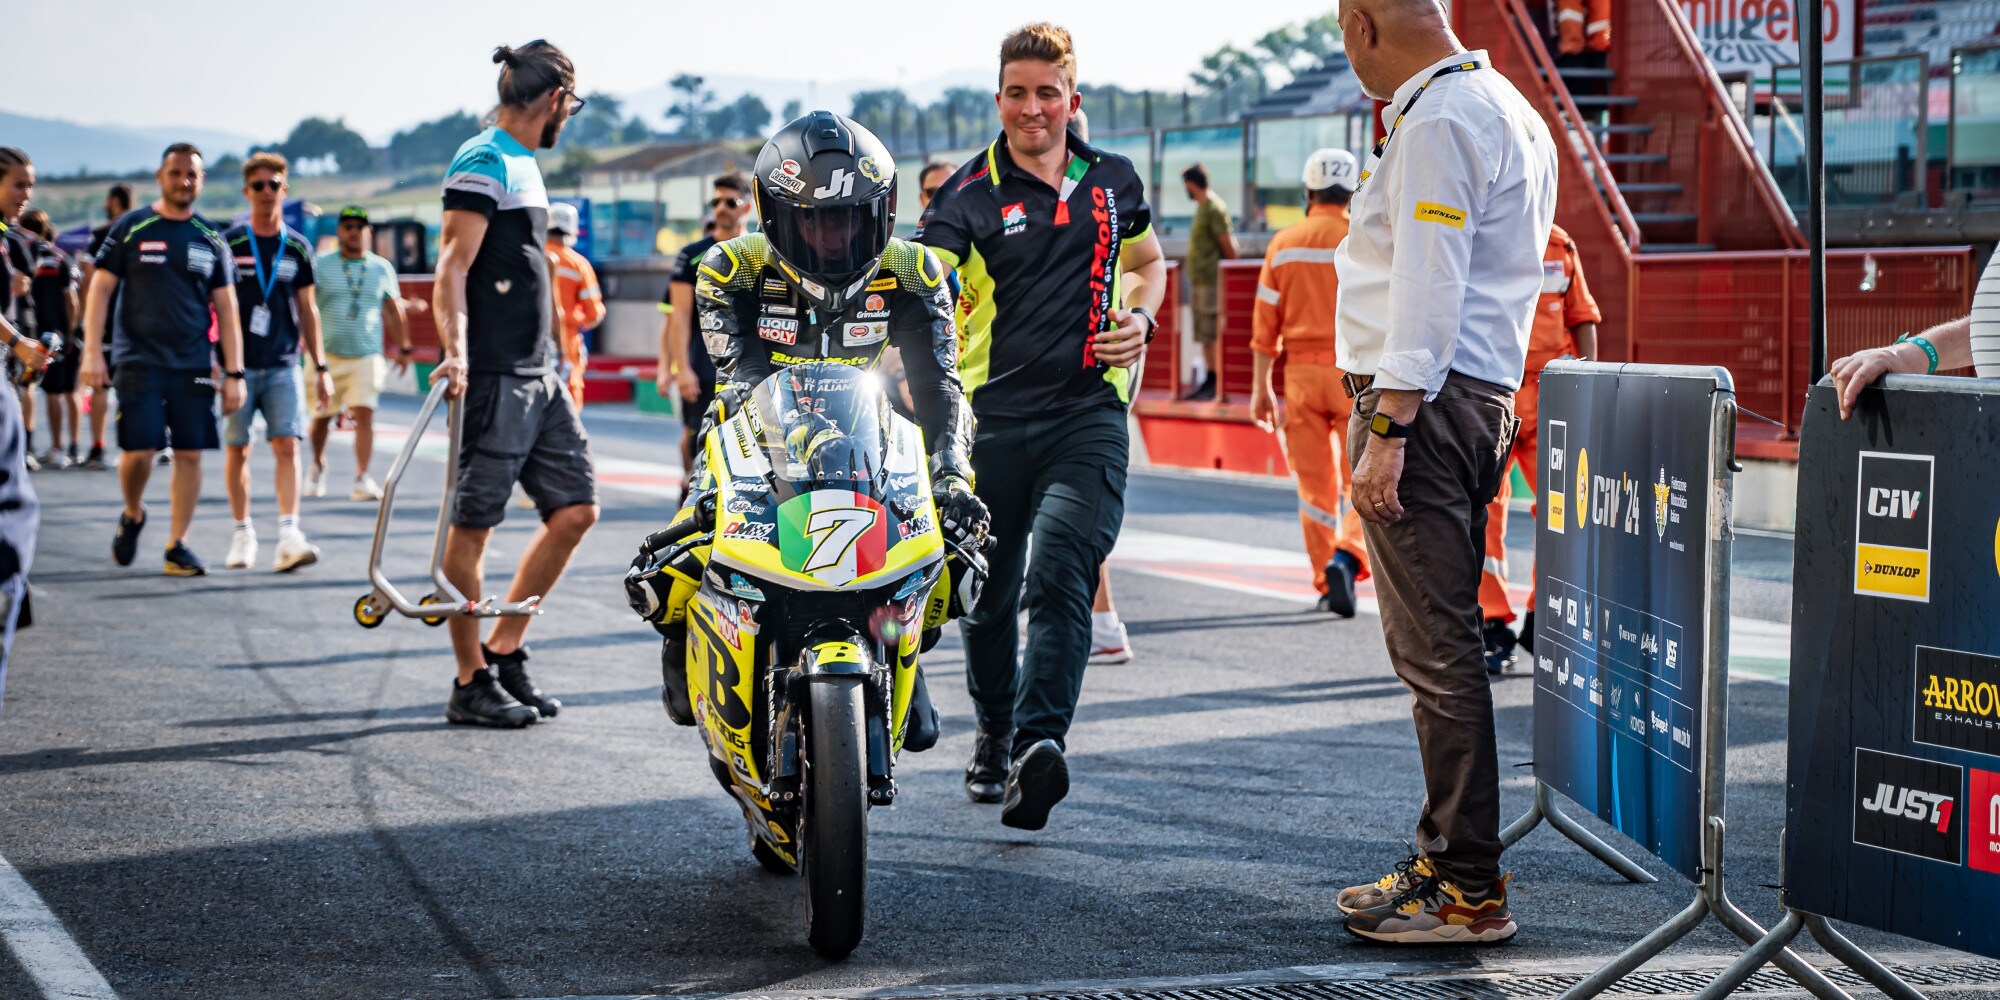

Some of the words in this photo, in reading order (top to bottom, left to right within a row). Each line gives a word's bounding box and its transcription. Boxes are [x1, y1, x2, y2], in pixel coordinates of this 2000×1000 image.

[1321, 161, 1351, 177] 127
[1428, 209, 1461, 222] DUNLOP
[760, 318, 796, 331] LIQUI
[758, 327, 796, 343] MOLY
[802, 507, 877, 573] 7
[1873, 563, 1921, 578] DUNLOP
[1862, 783, 1954, 833] JUST1
